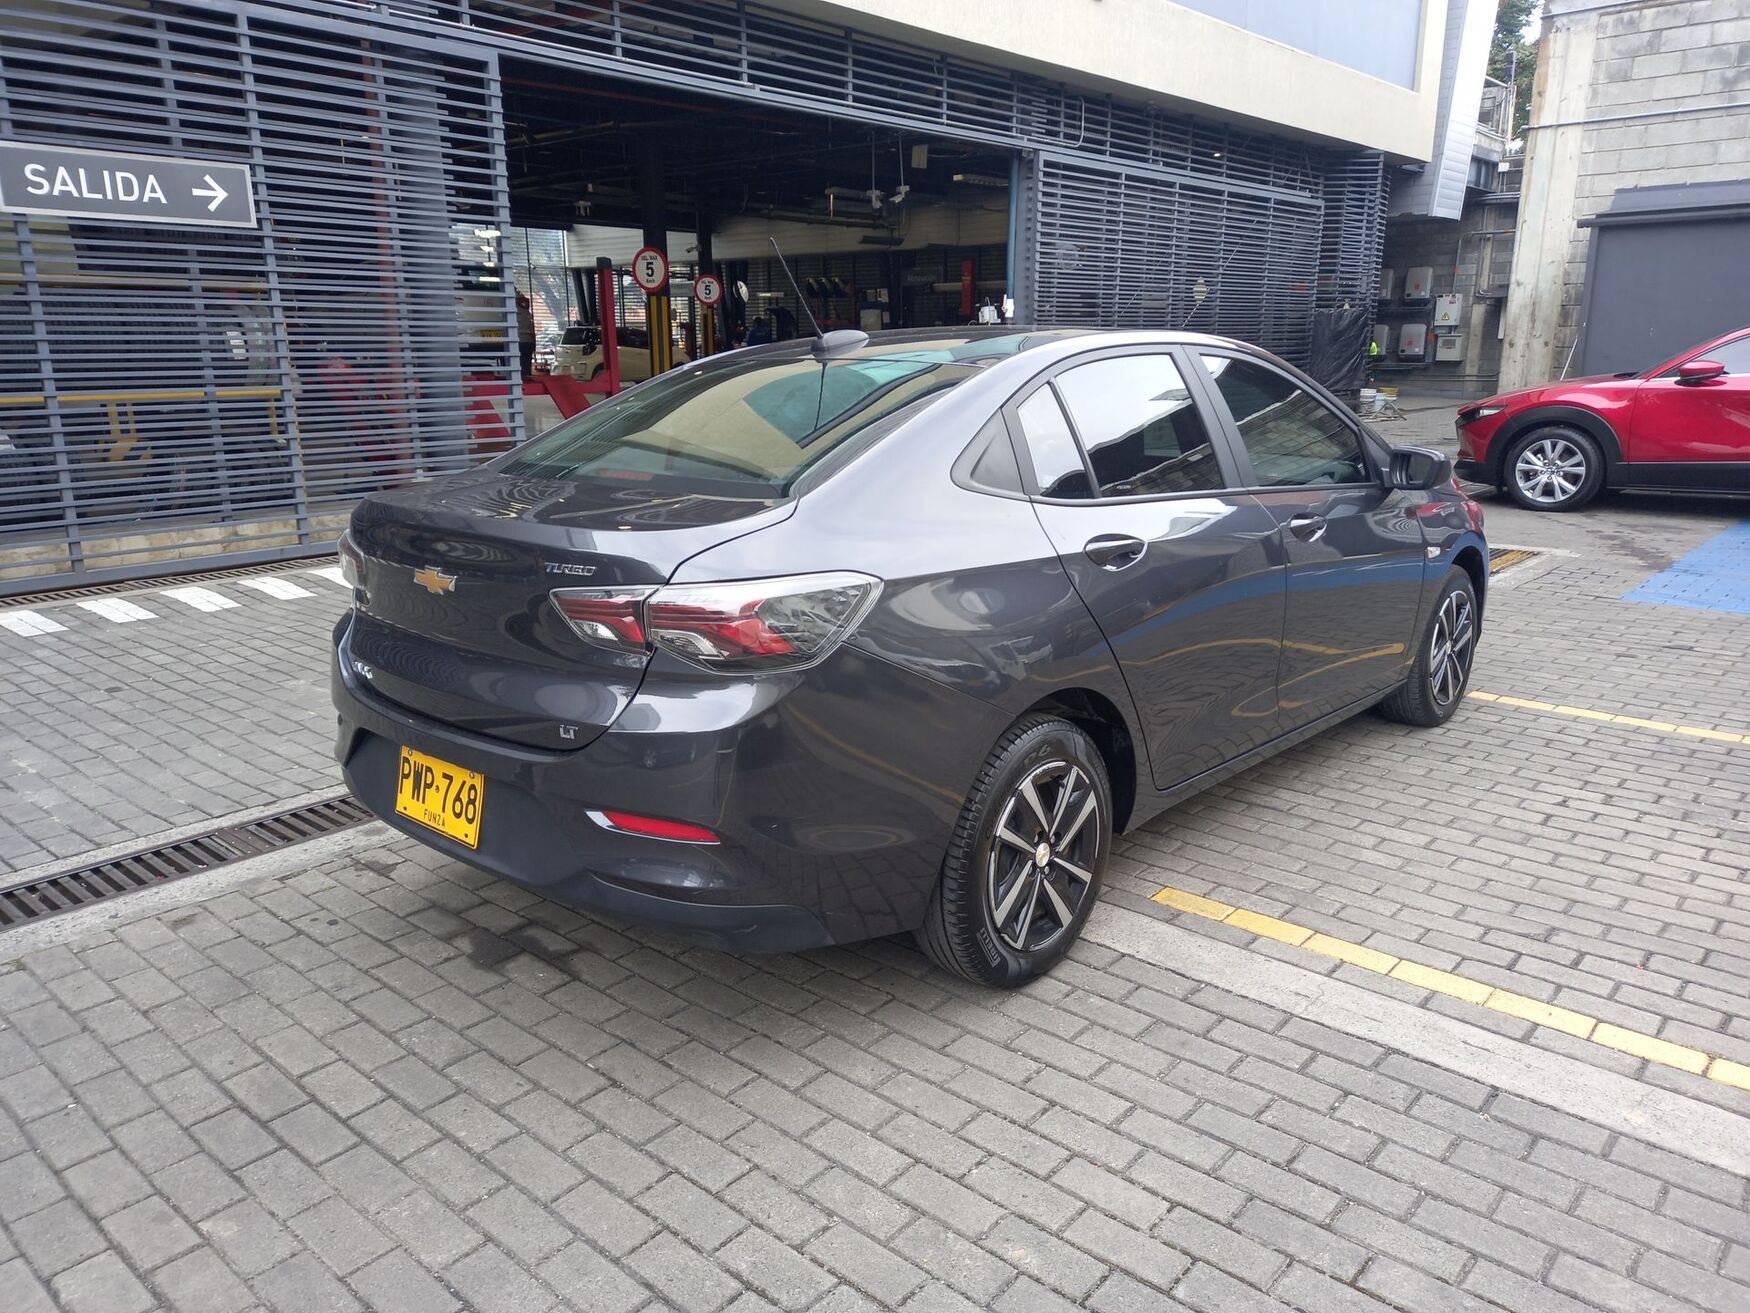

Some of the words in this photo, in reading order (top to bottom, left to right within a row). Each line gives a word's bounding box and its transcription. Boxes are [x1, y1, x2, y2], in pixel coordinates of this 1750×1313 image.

[24, 163, 168, 204] SALIDA
[646, 261, 655, 278] 5
[704, 284, 712, 296] 5
[544, 562, 597, 576] TURBO
[560, 724, 579, 739] LT
[424, 808, 446, 828] FUNZA
